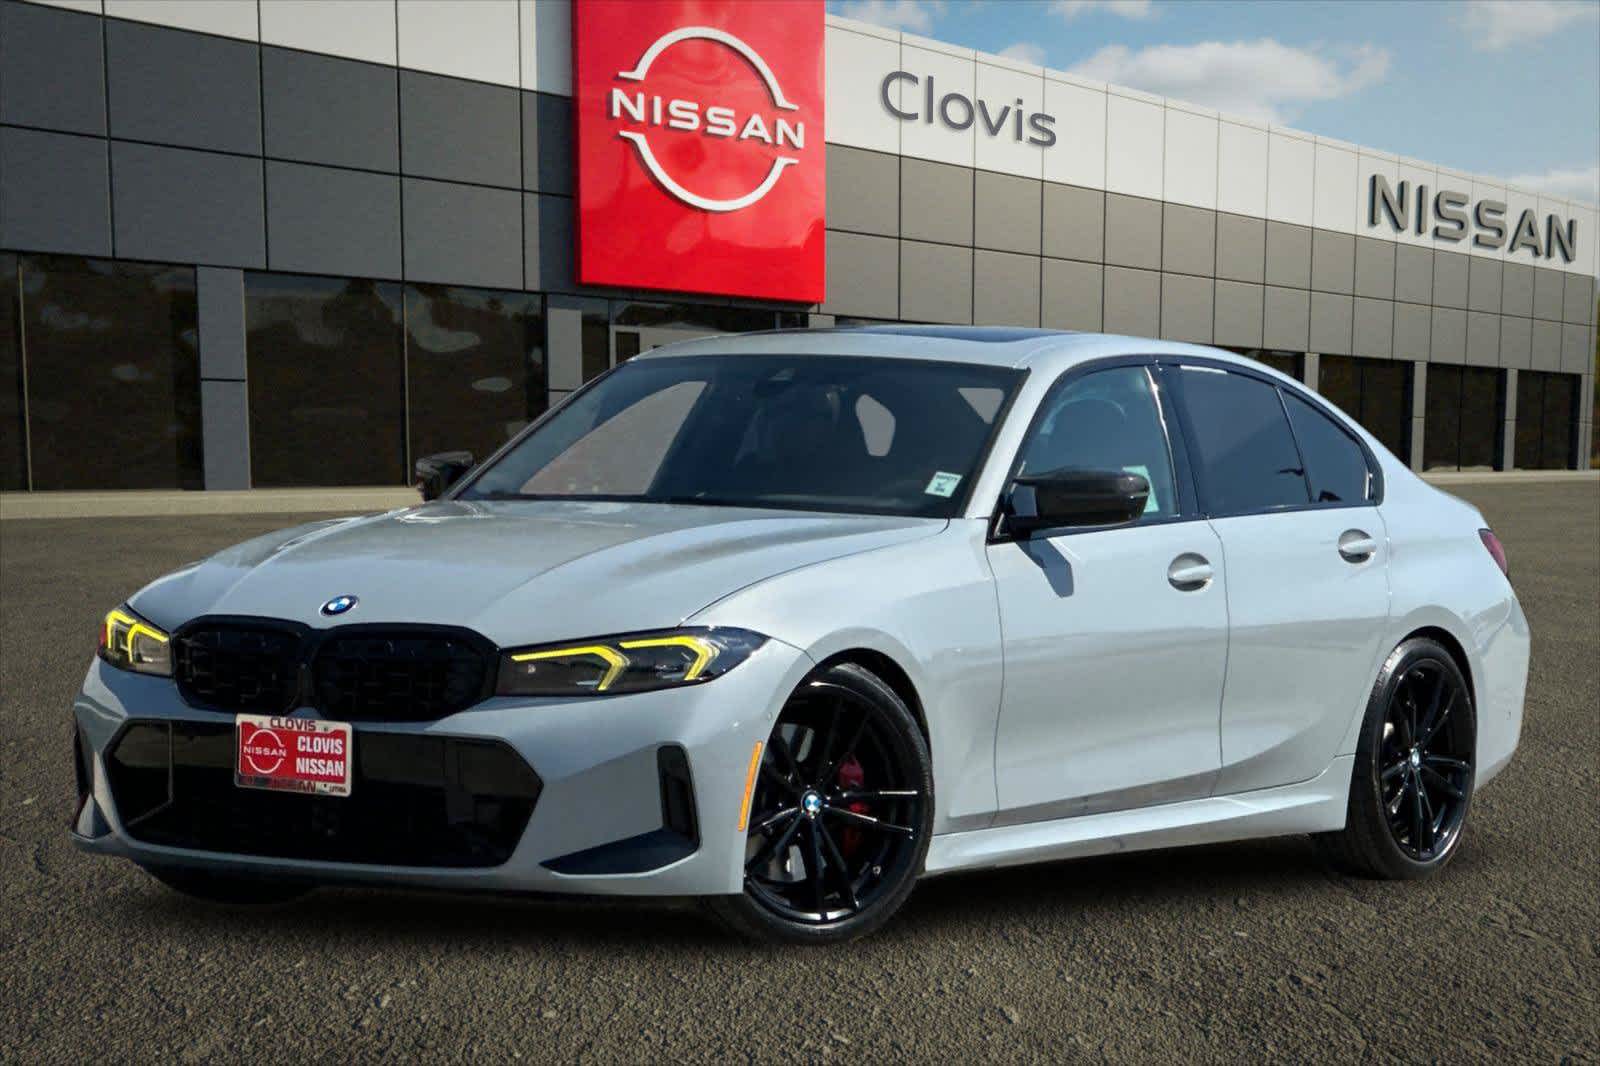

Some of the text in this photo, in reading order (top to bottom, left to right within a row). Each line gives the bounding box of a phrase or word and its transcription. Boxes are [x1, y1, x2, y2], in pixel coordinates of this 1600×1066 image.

[610, 87, 805, 149] NISSAN
[882, 71, 1056, 147] Clovis
[1369, 173, 1578, 263] NISSAN
[270, 717, 316, 731] CLOVIS
[243, 746, 286, 757] NISSAN
[297, 736, 343, 754] CLOVIS
[296, 757, 344, 776] NISSAN
